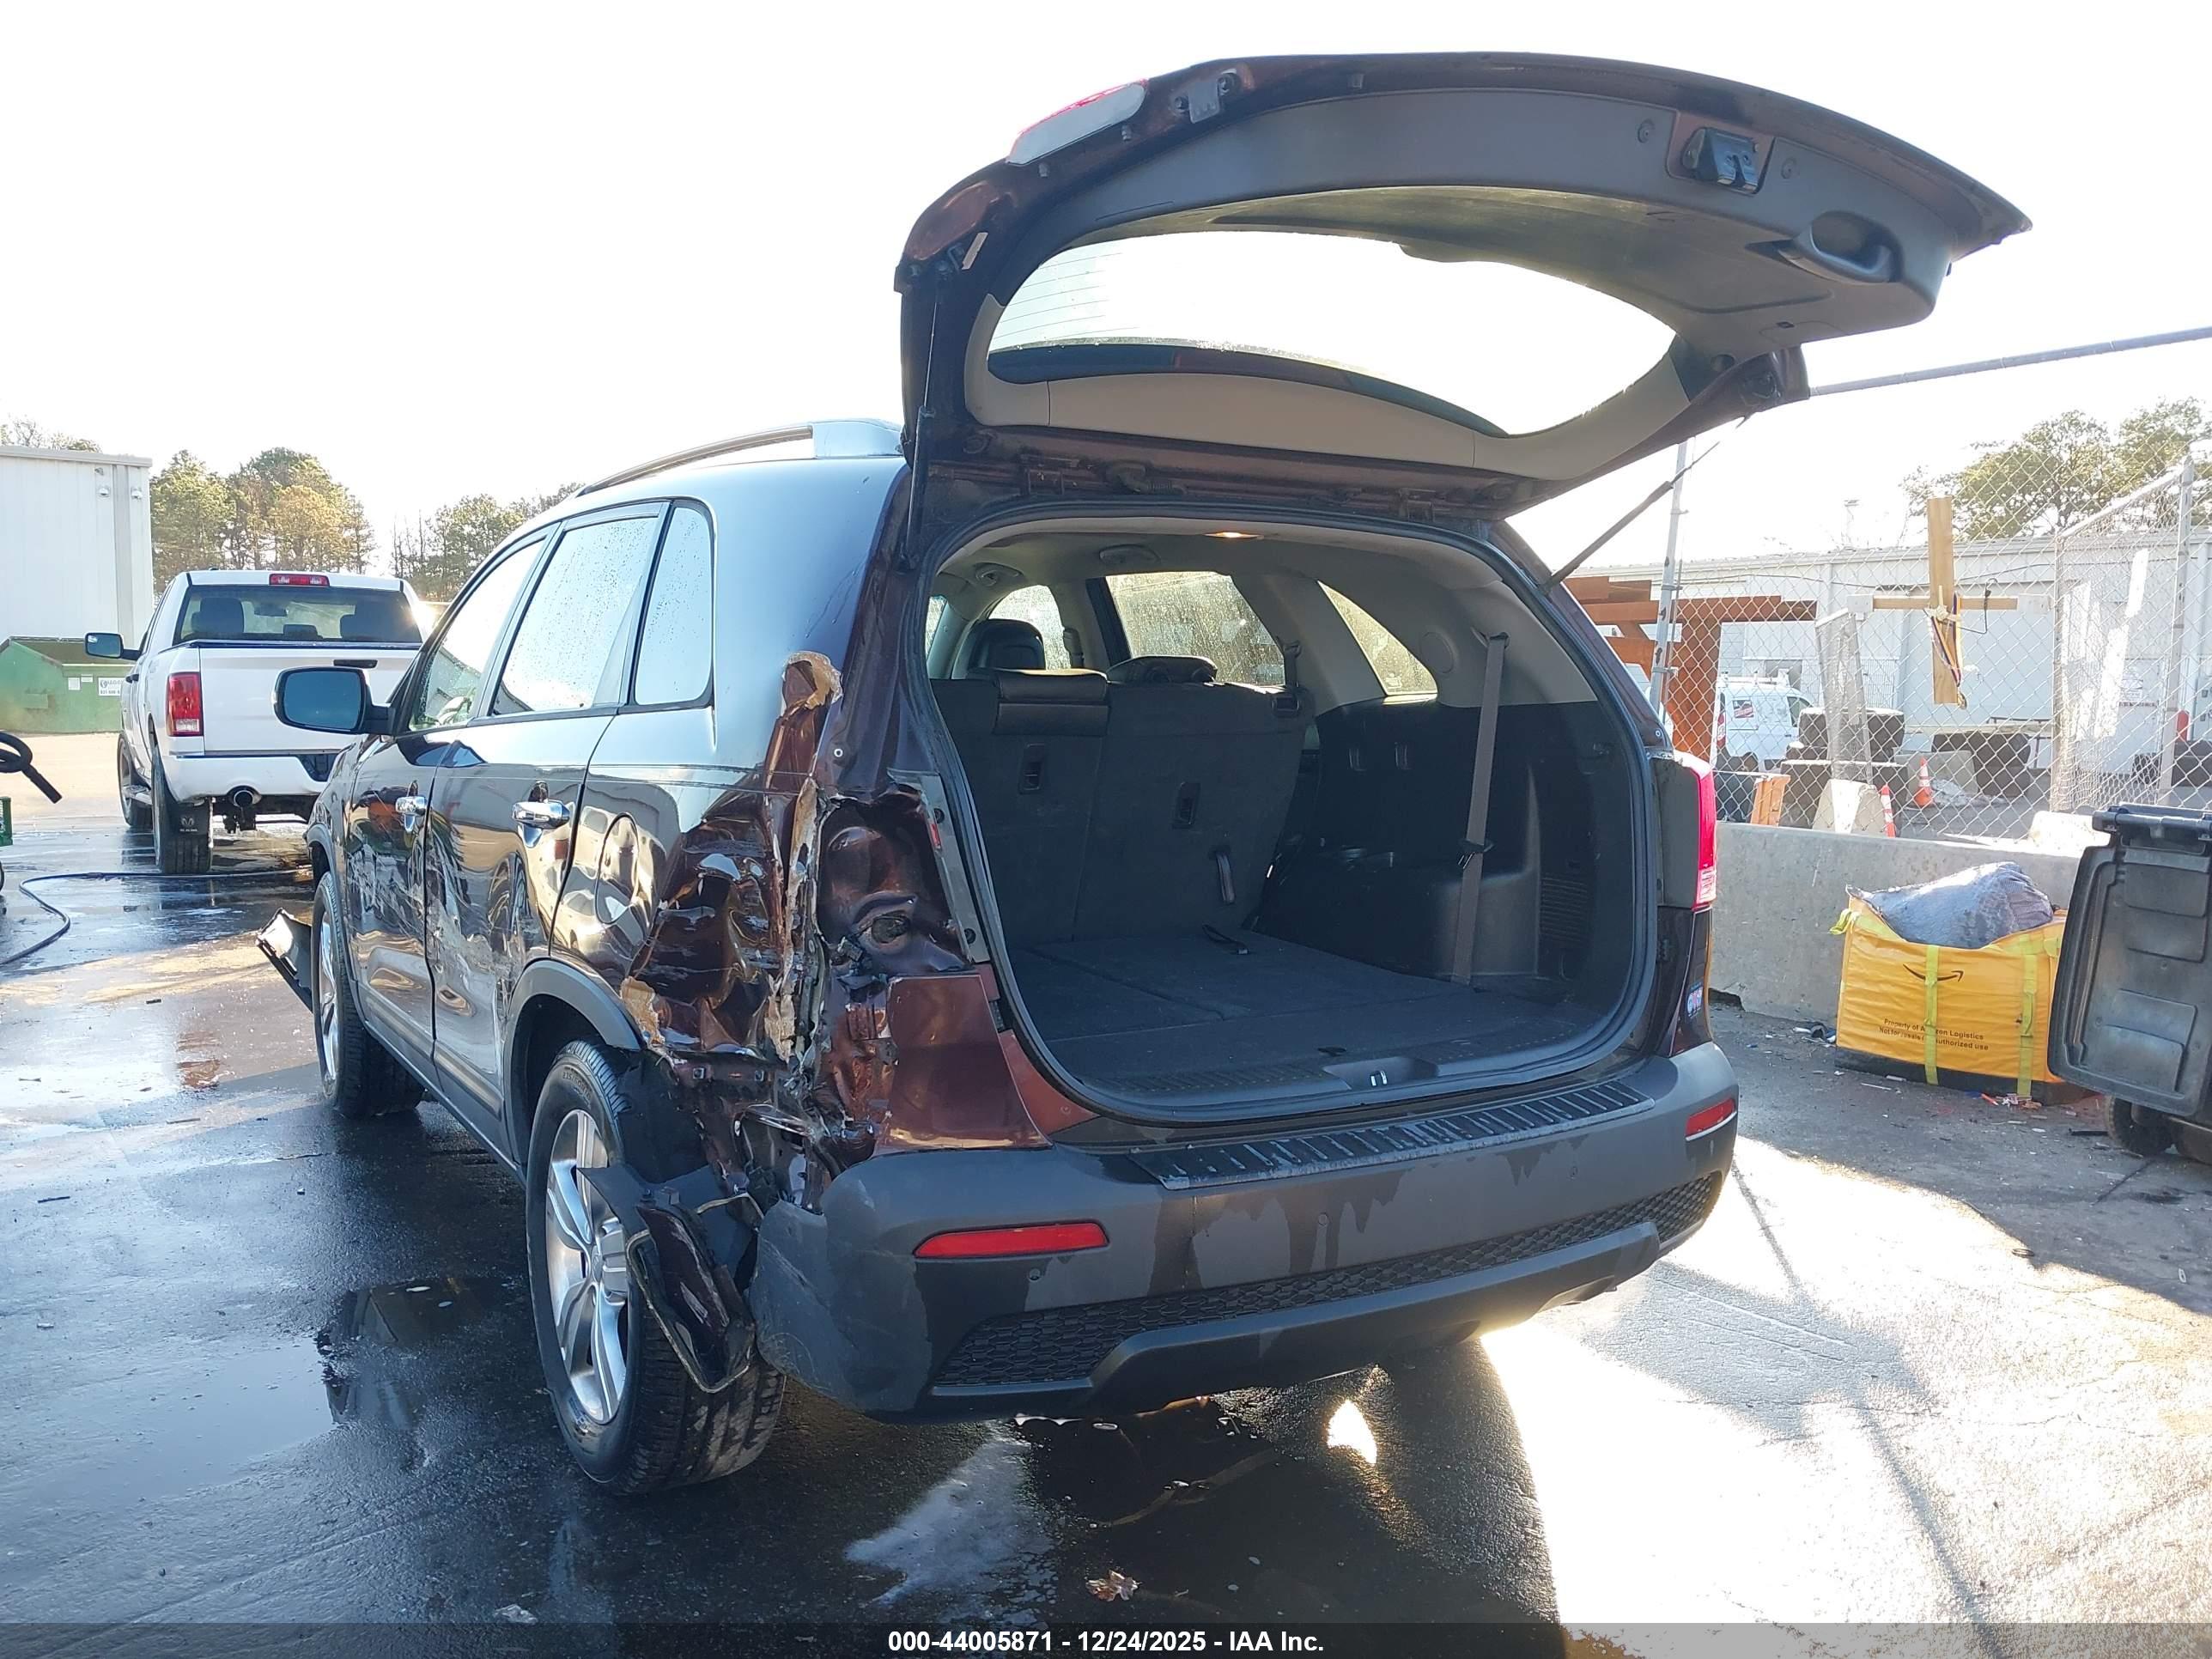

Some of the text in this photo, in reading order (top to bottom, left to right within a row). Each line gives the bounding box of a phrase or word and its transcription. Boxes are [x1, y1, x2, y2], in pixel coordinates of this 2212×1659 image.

[1879, 1026, 1891, 1035] Not
[1884, 1018, 1911, 1030] Property
[1949, 1030, 1984, 1041] Logistics
